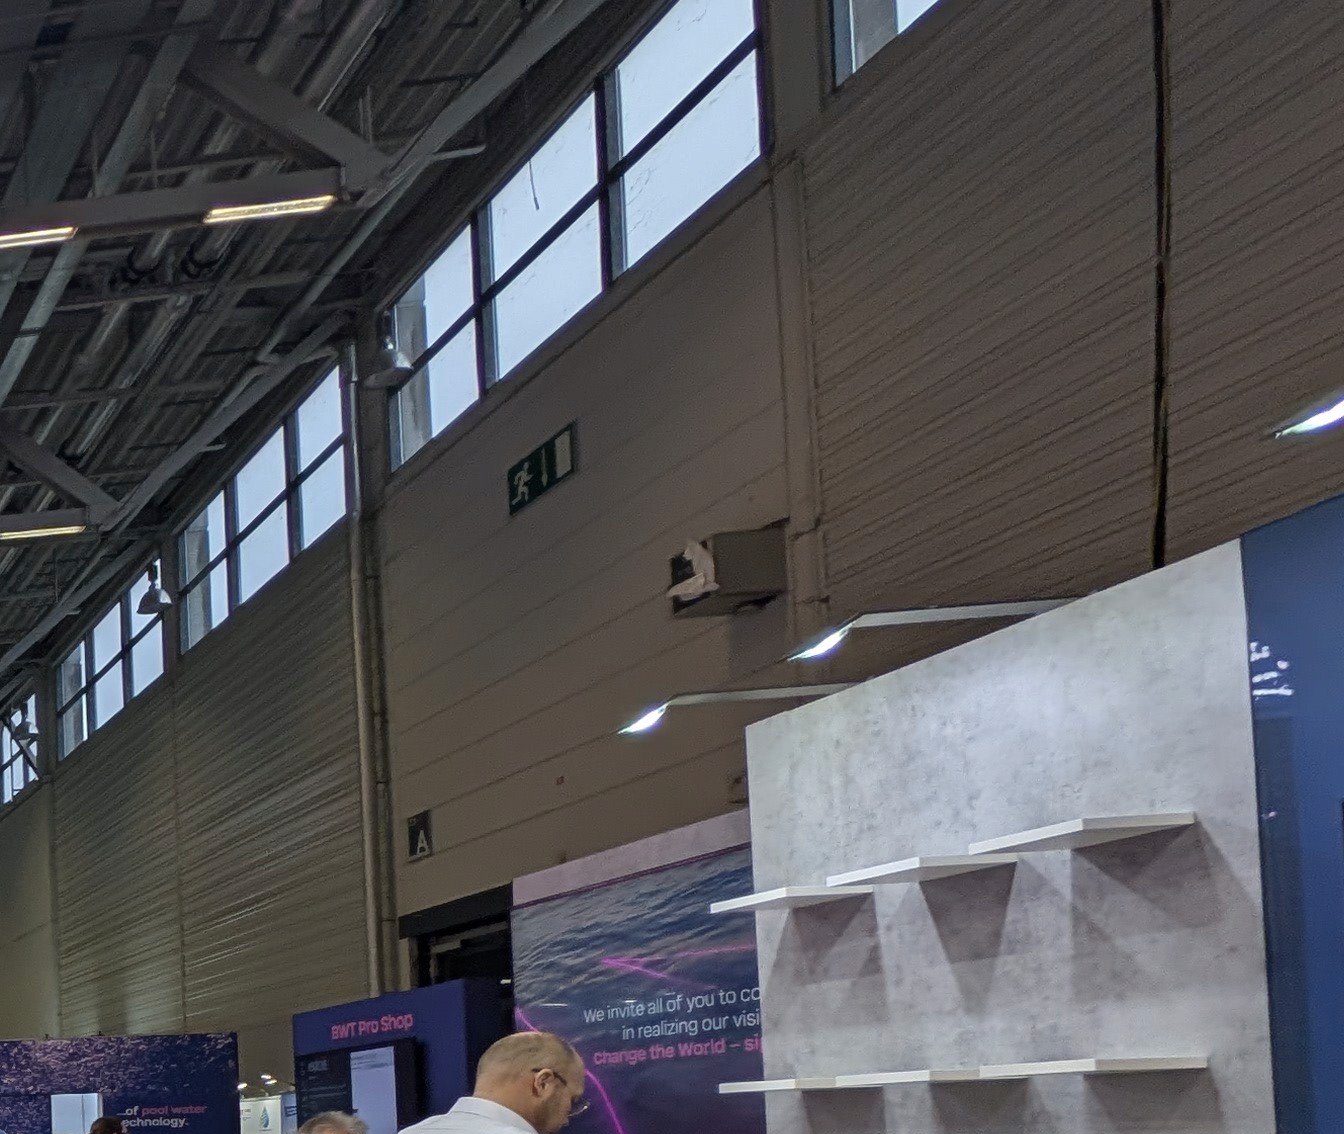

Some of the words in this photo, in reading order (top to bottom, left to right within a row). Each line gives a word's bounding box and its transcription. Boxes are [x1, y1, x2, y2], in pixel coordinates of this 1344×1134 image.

[583, 1008, 605, 1023] We
[607, 1002, 645, 1020] invite
[647, 998, 662, 1015] all
[666, 994, 682, 1012] of
[686, 994, 715, 1013] you
[719, 989, 736, 1005] to
[331, 1021, 357, 1040] BWT
[358, 1020, 379, 1036] Pro
[380, 1013, 414, 1032] Shop
[622, 1025, 635, 1040] in
[637, 1018, 699, 1039] realizing
[701, 1016, 729, 1031] our
[593, 1047, 647, 1065] change
[649, 1044, 674, 1059] the
[678, 1038, 726, 1056] World
[141, 1105, 169, 1116] pool
[171, 1105, 207, 1114] water
